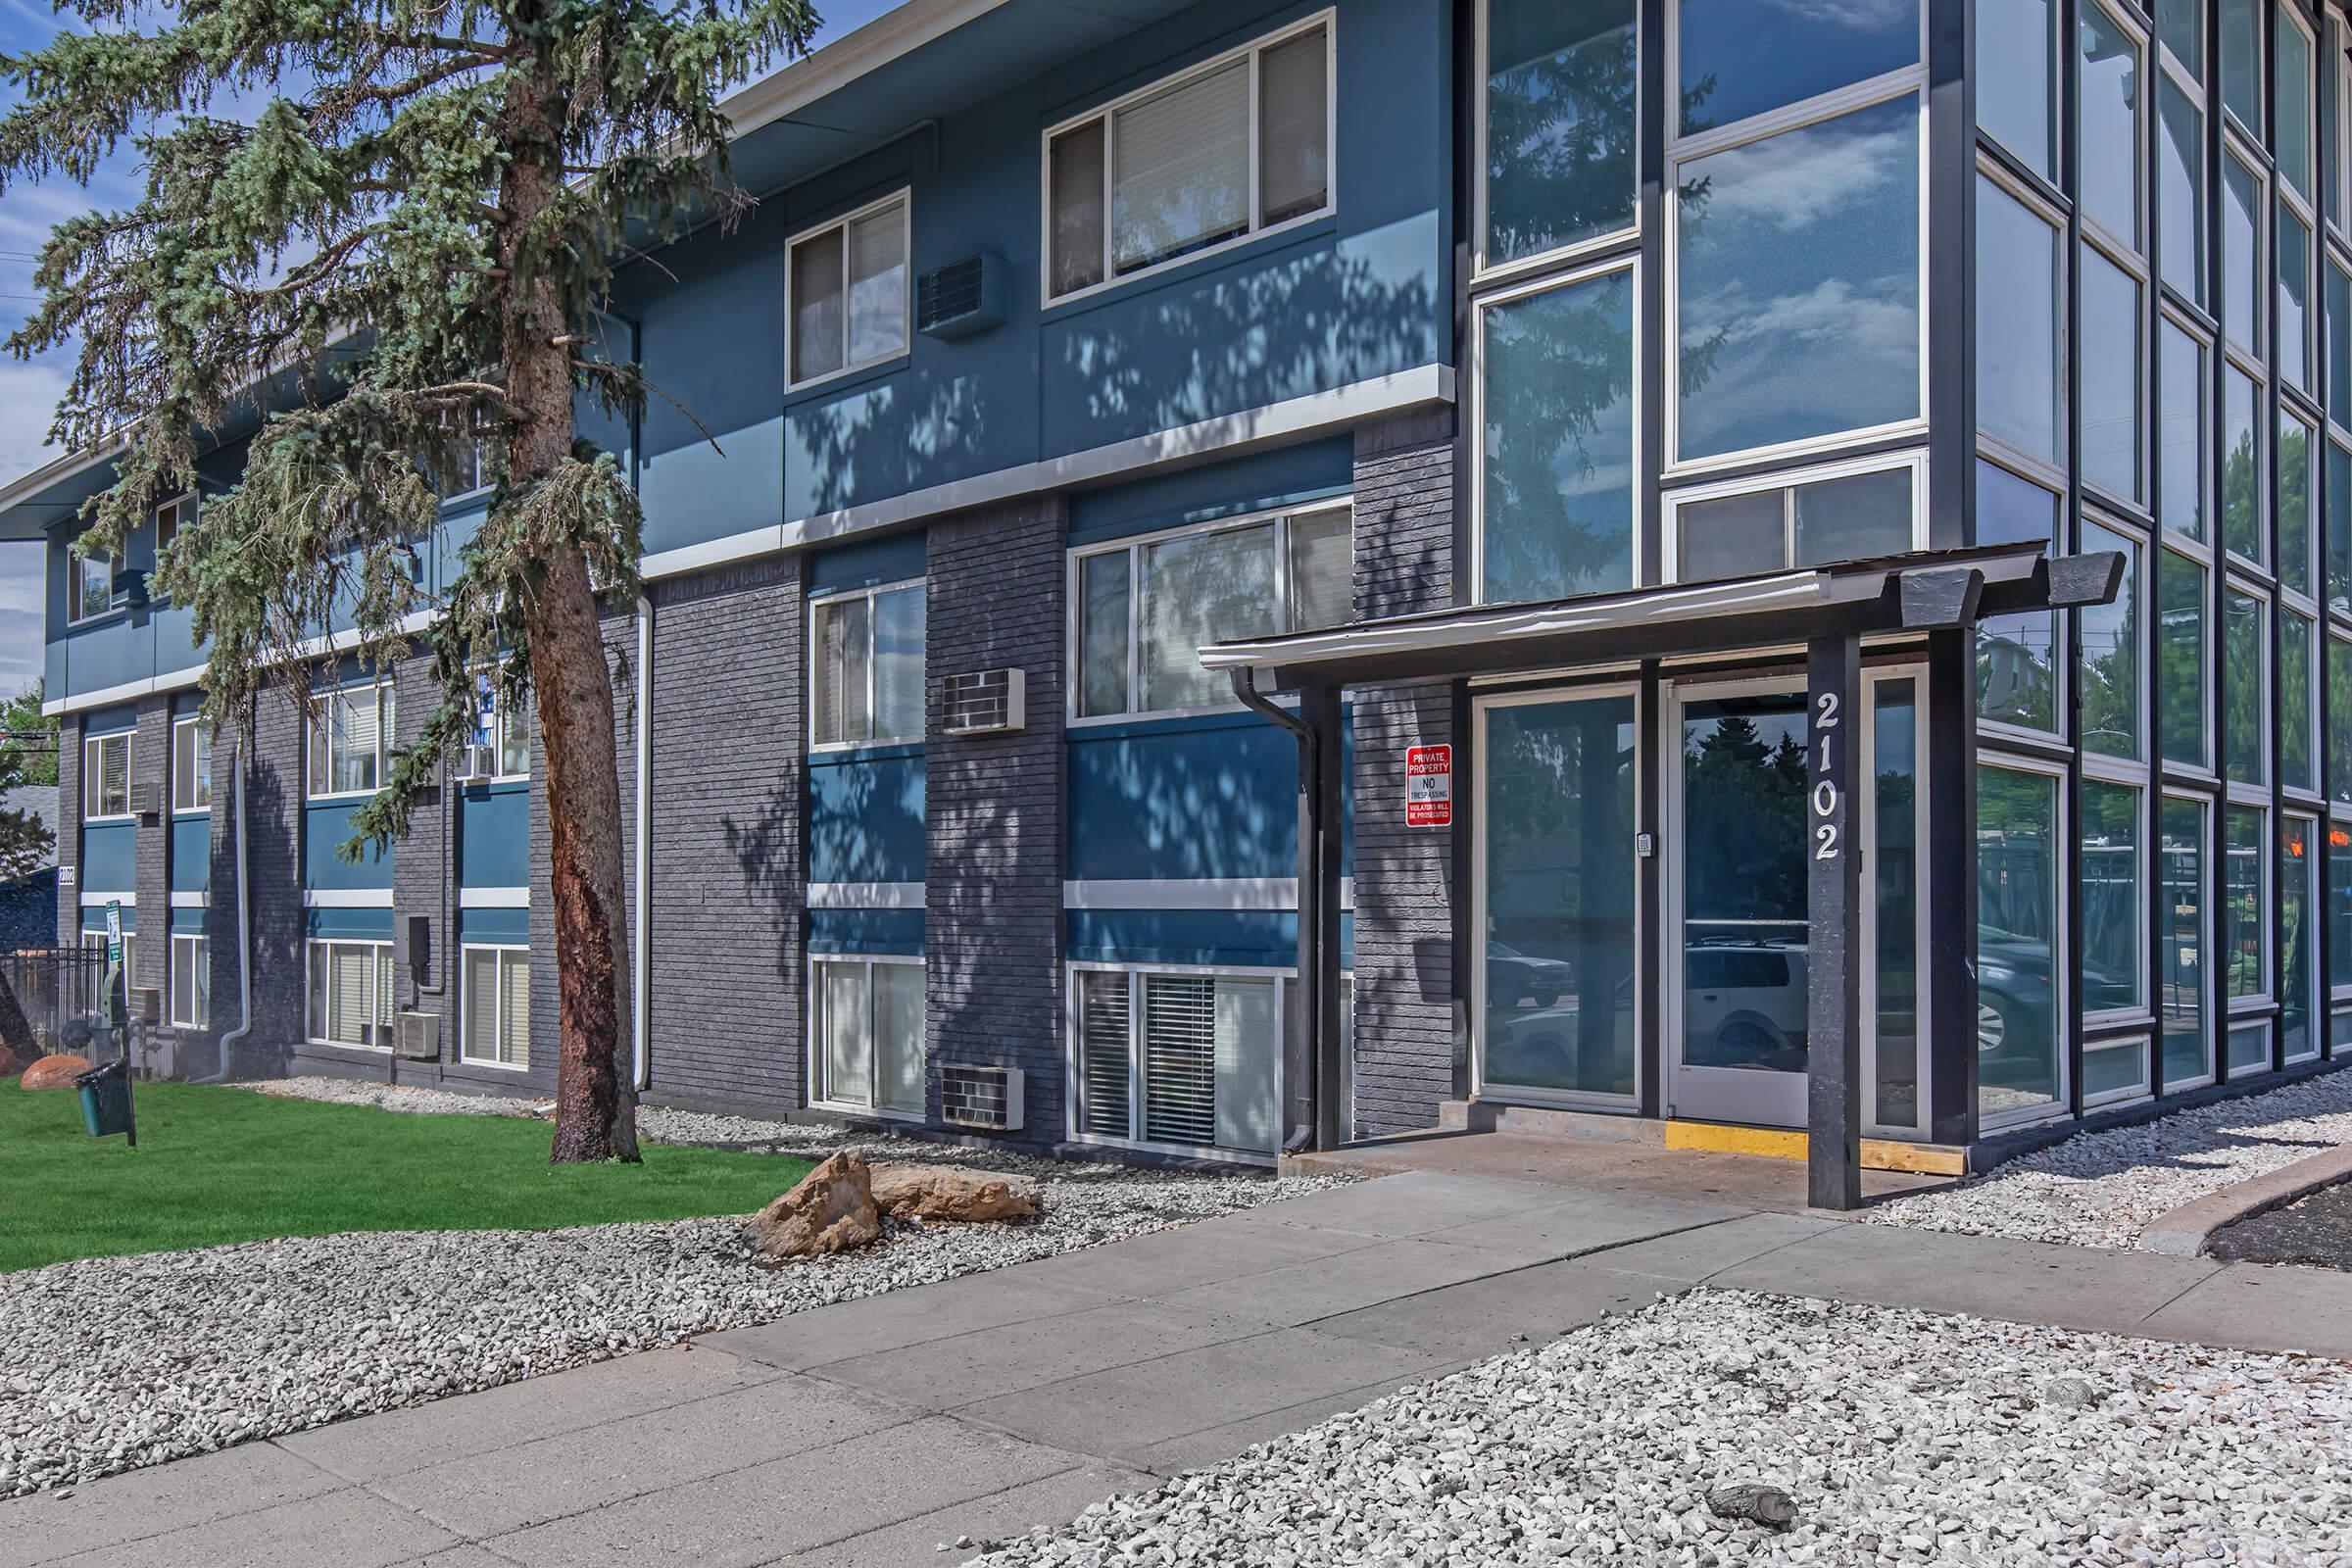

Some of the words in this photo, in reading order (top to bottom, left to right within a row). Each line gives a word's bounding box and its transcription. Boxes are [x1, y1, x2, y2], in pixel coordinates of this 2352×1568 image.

[1413, 753, 1445, 763] PRIVATE
[1409, 762, 1449, 773] PROPERTY
[1814, 692, 1838, 860] 2102
[1422, 777, 1436, 790] NO
[1411, 791, 1447, 800] TRESPASSING
[60, 868, 74, 883] 2102
